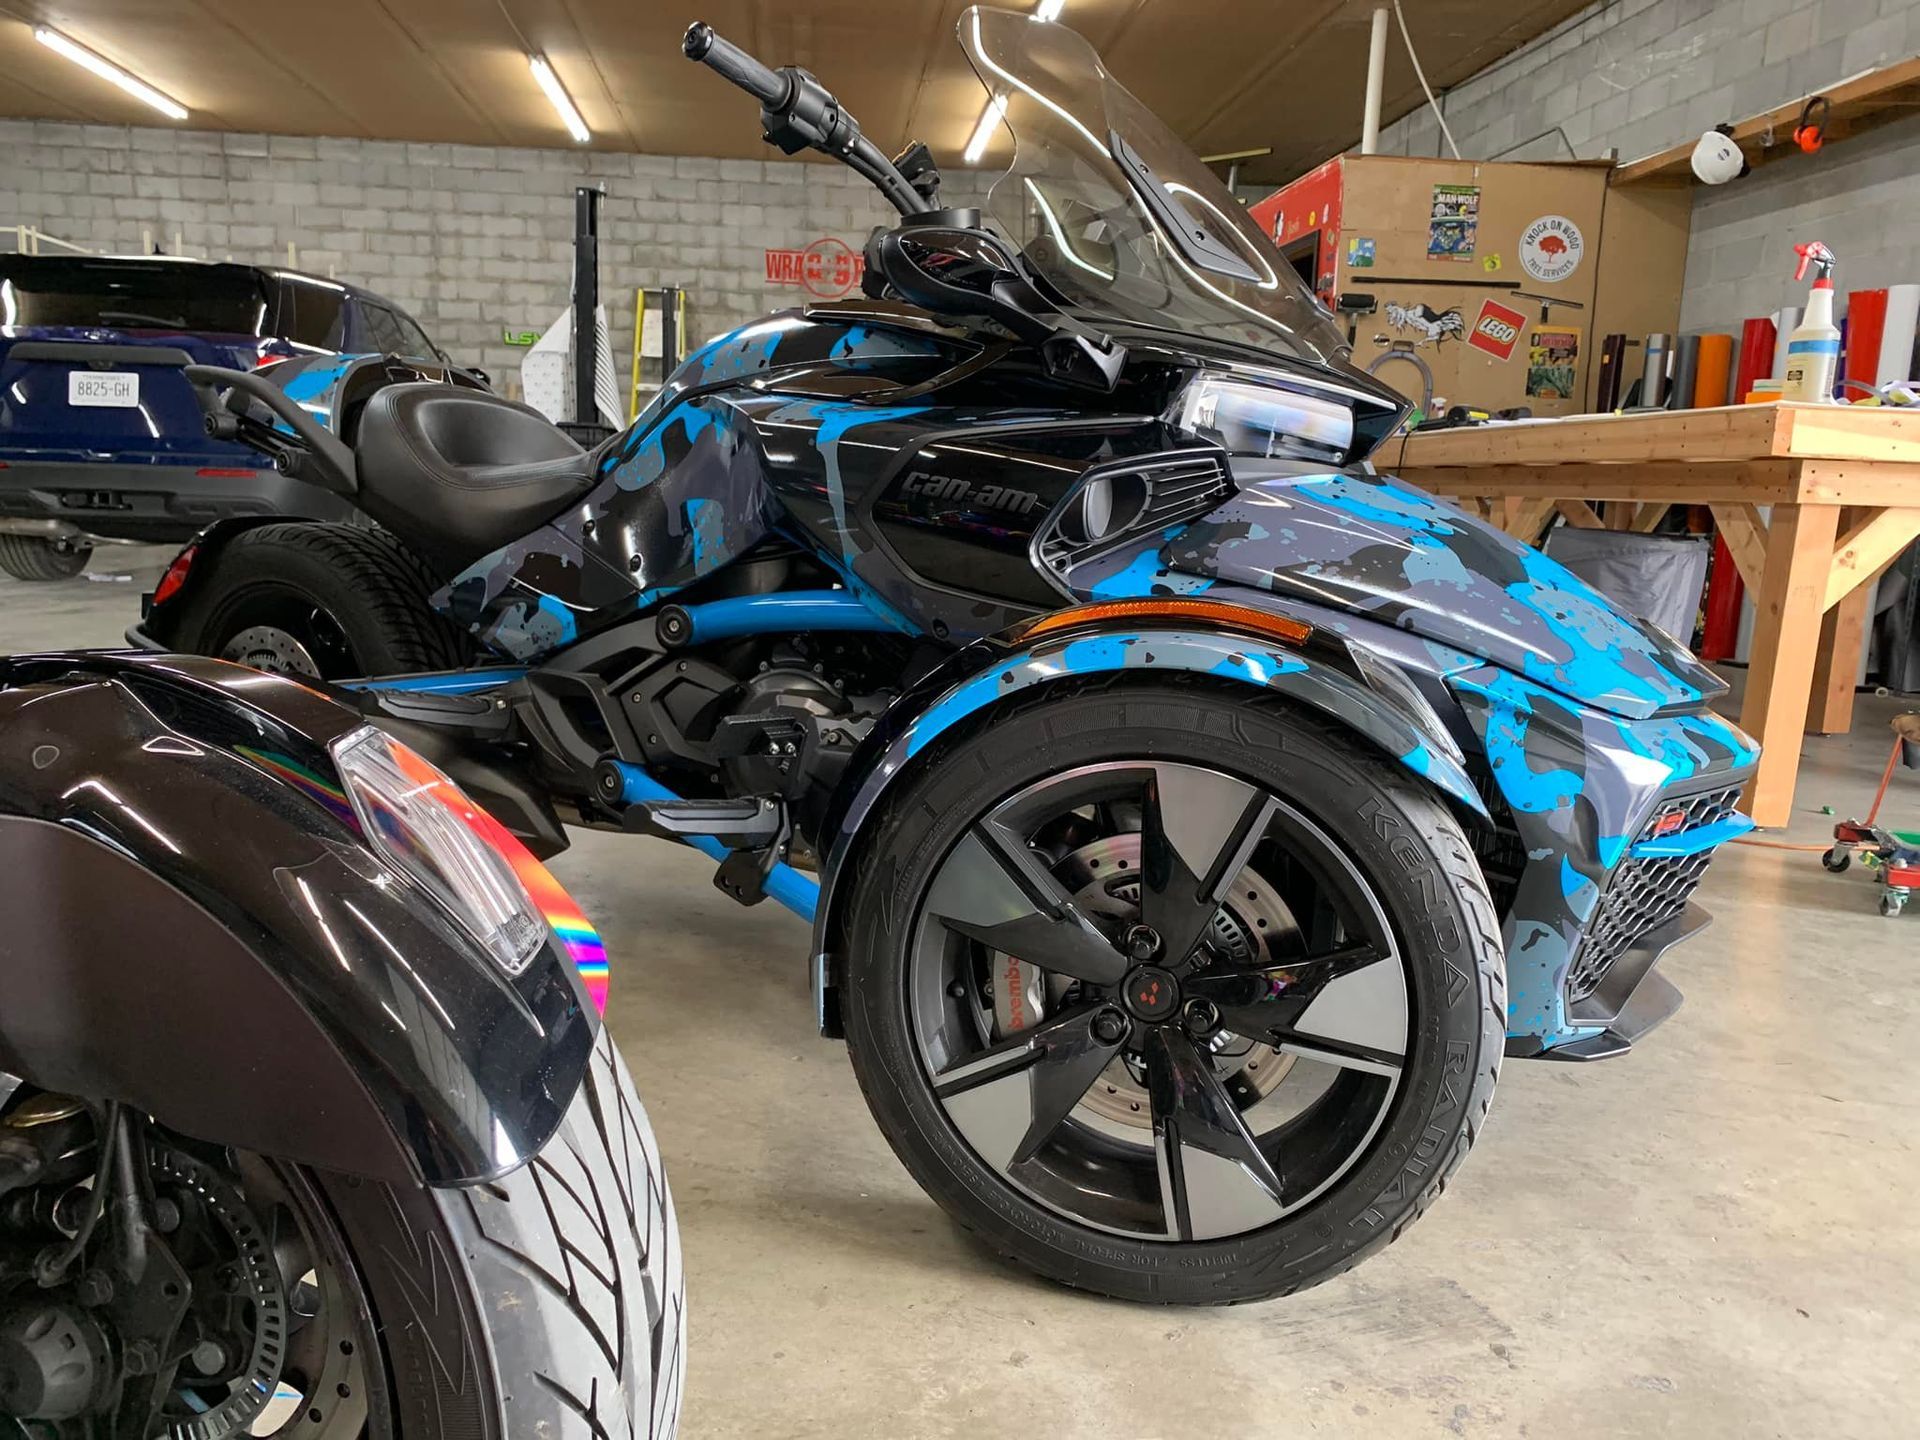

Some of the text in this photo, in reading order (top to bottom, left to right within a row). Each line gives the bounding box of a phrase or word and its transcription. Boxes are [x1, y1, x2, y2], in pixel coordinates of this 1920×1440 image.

[1526, 219, 1580, 249] KNOCK ON WOOD
[1528, 258, 1574, 277] TREE SERVICES
[1479, 317, 1516, 342] LEGO
[78, 382, 130, 397] 8825-GH
[1357, 797, 1471, 1008] KENDA
[1004, 956, 1024, 1029] brembo
[1349, 1040, 1471, 1227] RADIAL
